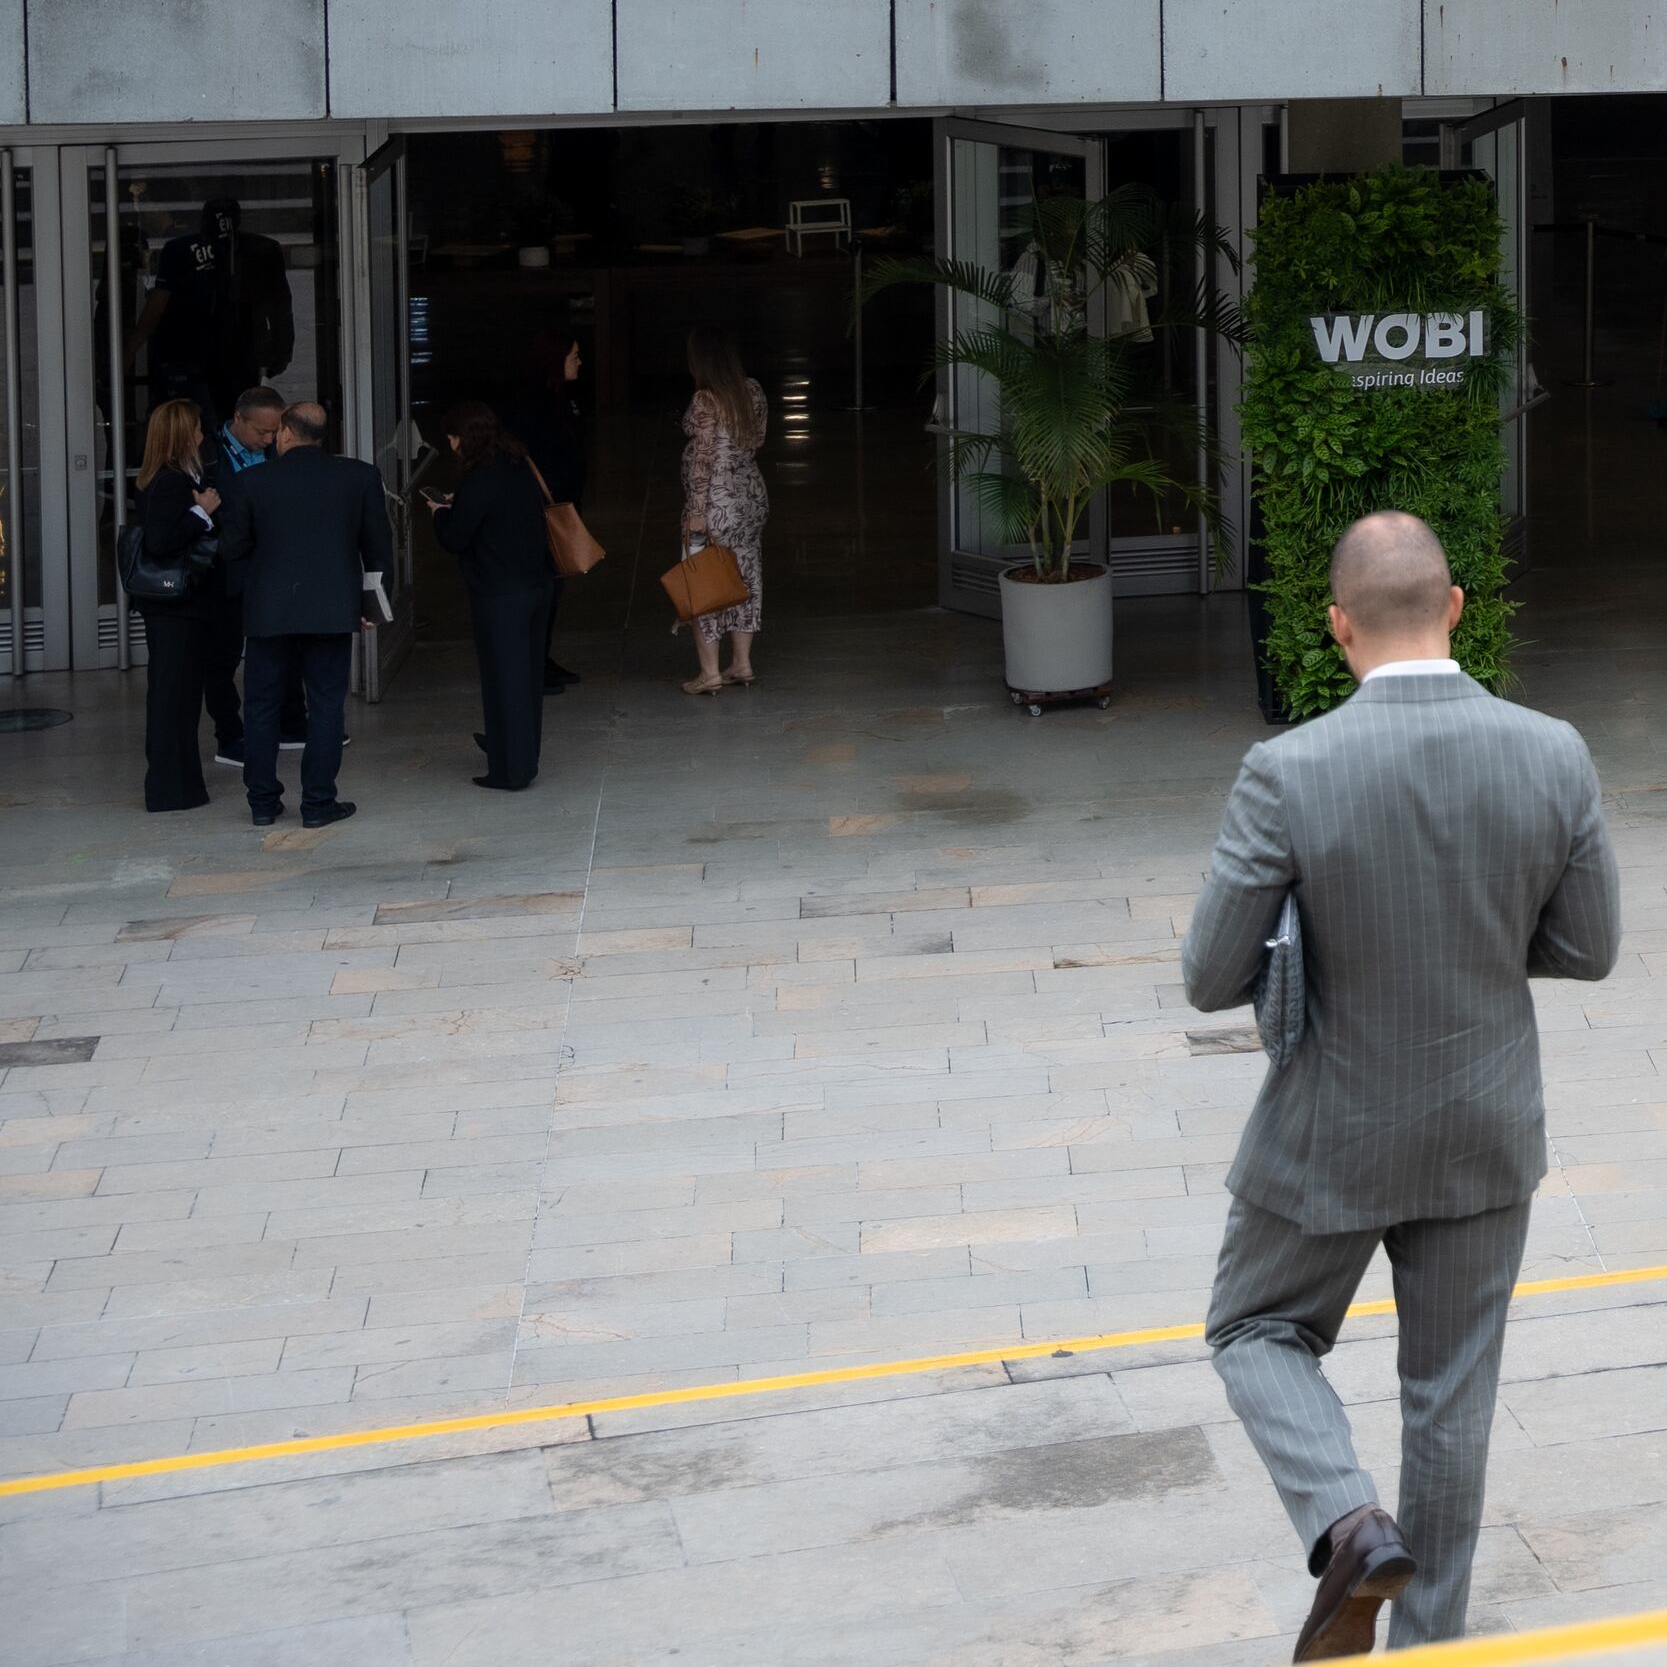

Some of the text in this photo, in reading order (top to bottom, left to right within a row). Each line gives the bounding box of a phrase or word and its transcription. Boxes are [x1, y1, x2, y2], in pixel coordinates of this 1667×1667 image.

[1310, 310, 1483, 363] WOBI
[1352, 368, 1464, 391] spiring Ideas
